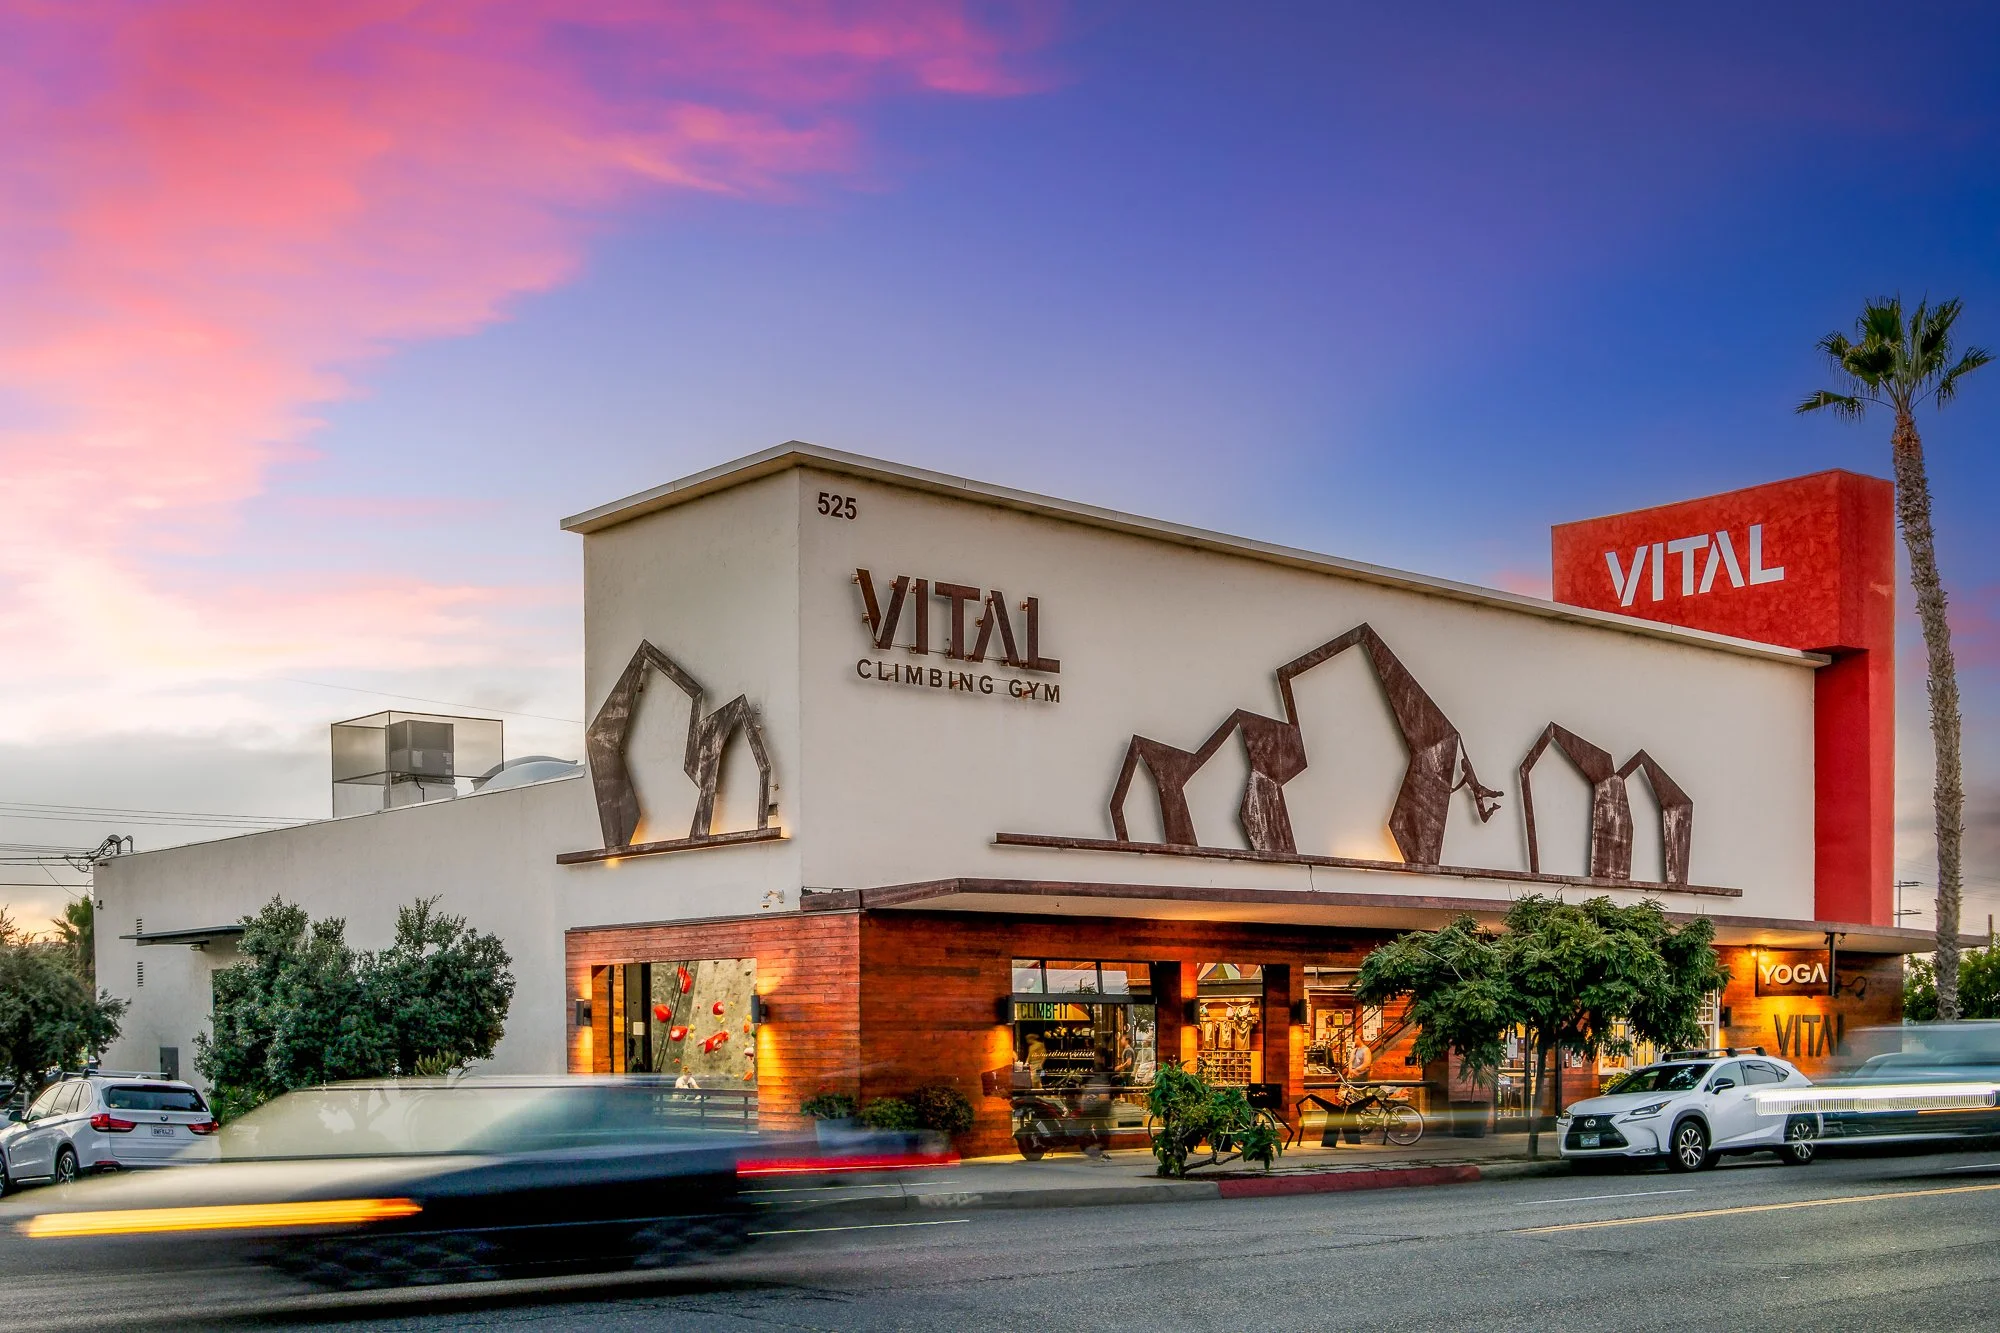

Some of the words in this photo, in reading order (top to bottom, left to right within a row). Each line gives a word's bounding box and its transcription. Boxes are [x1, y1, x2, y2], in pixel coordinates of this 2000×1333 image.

[817, 491, 857, 520] 525
[1604, 524, 1785, 607] VITAL
[856, 567, 1060, 673] VITAL
[856, 658, 994, 694] CLIMBING
[1008, 679, 1060, 703] GYM
[1761, 963, 1828, 985] YOGA
